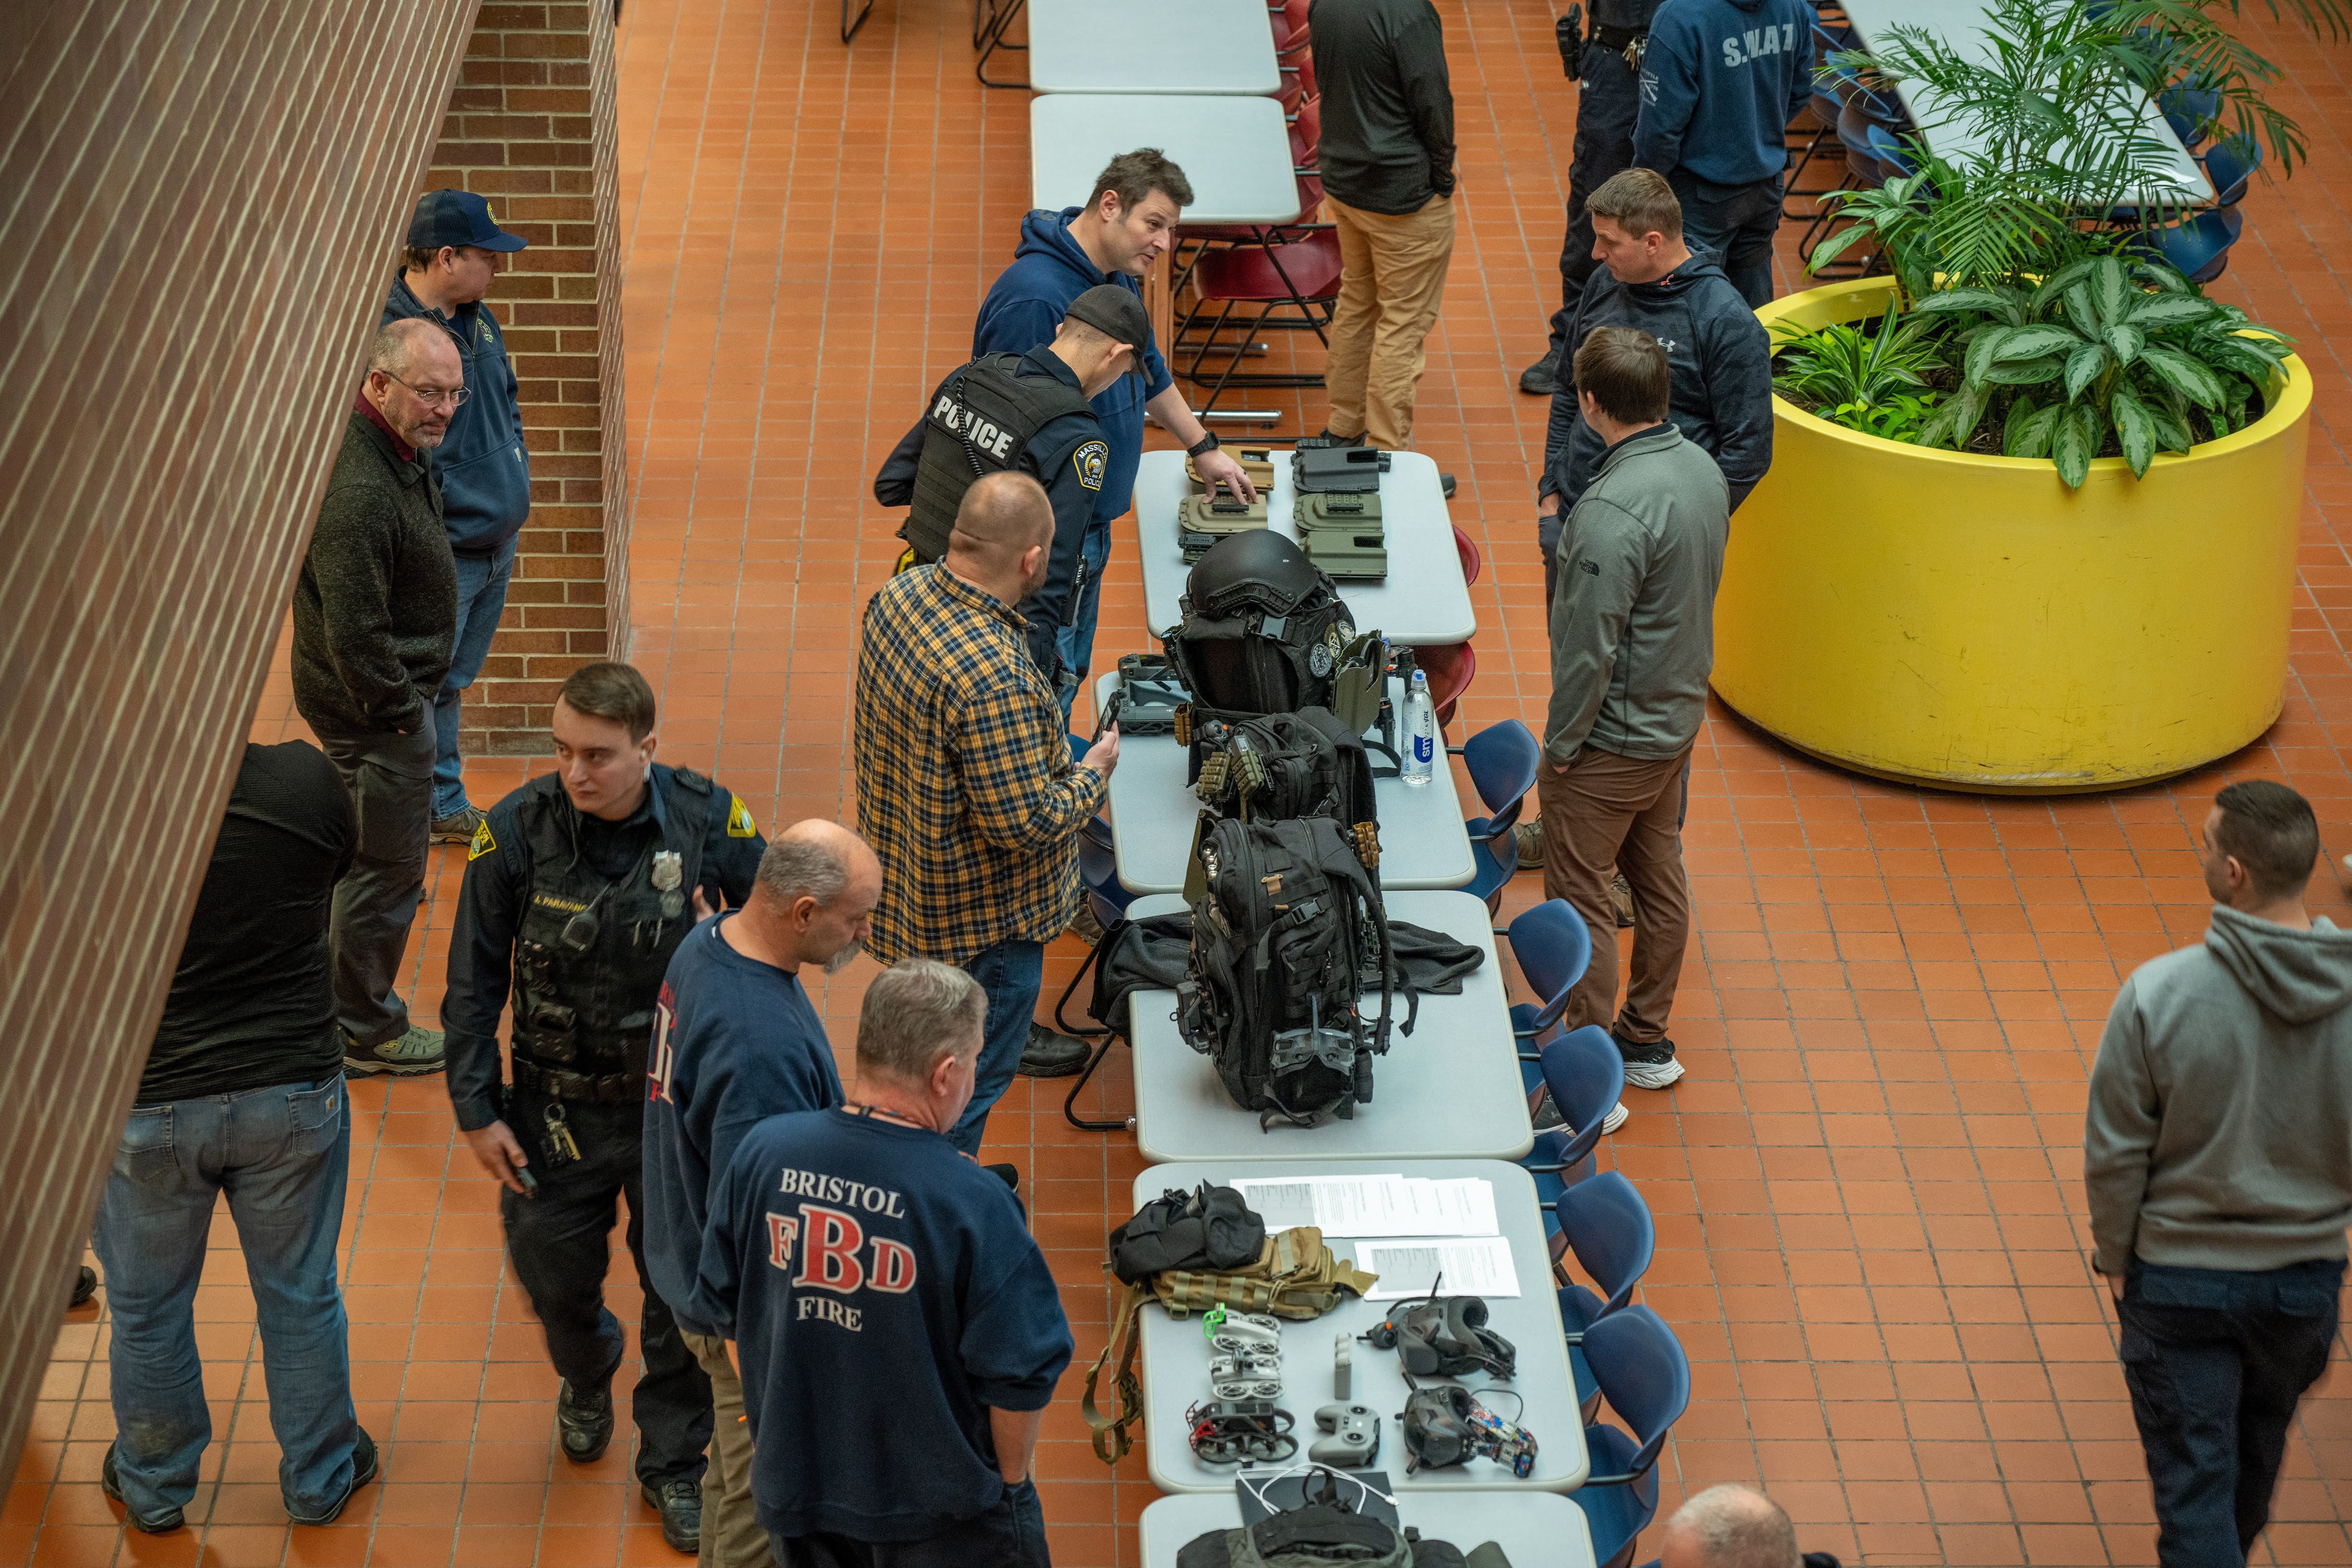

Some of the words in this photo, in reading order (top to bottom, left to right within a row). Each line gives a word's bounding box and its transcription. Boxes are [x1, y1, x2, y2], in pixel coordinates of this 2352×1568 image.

[1078, 444, 1107, 459] MASSILLO
[1084, 477, 1101, 487] POLICE
[778, 1167, 905, 1219] BRISTOL
[796, 1296, 862, 1332] FIRE
